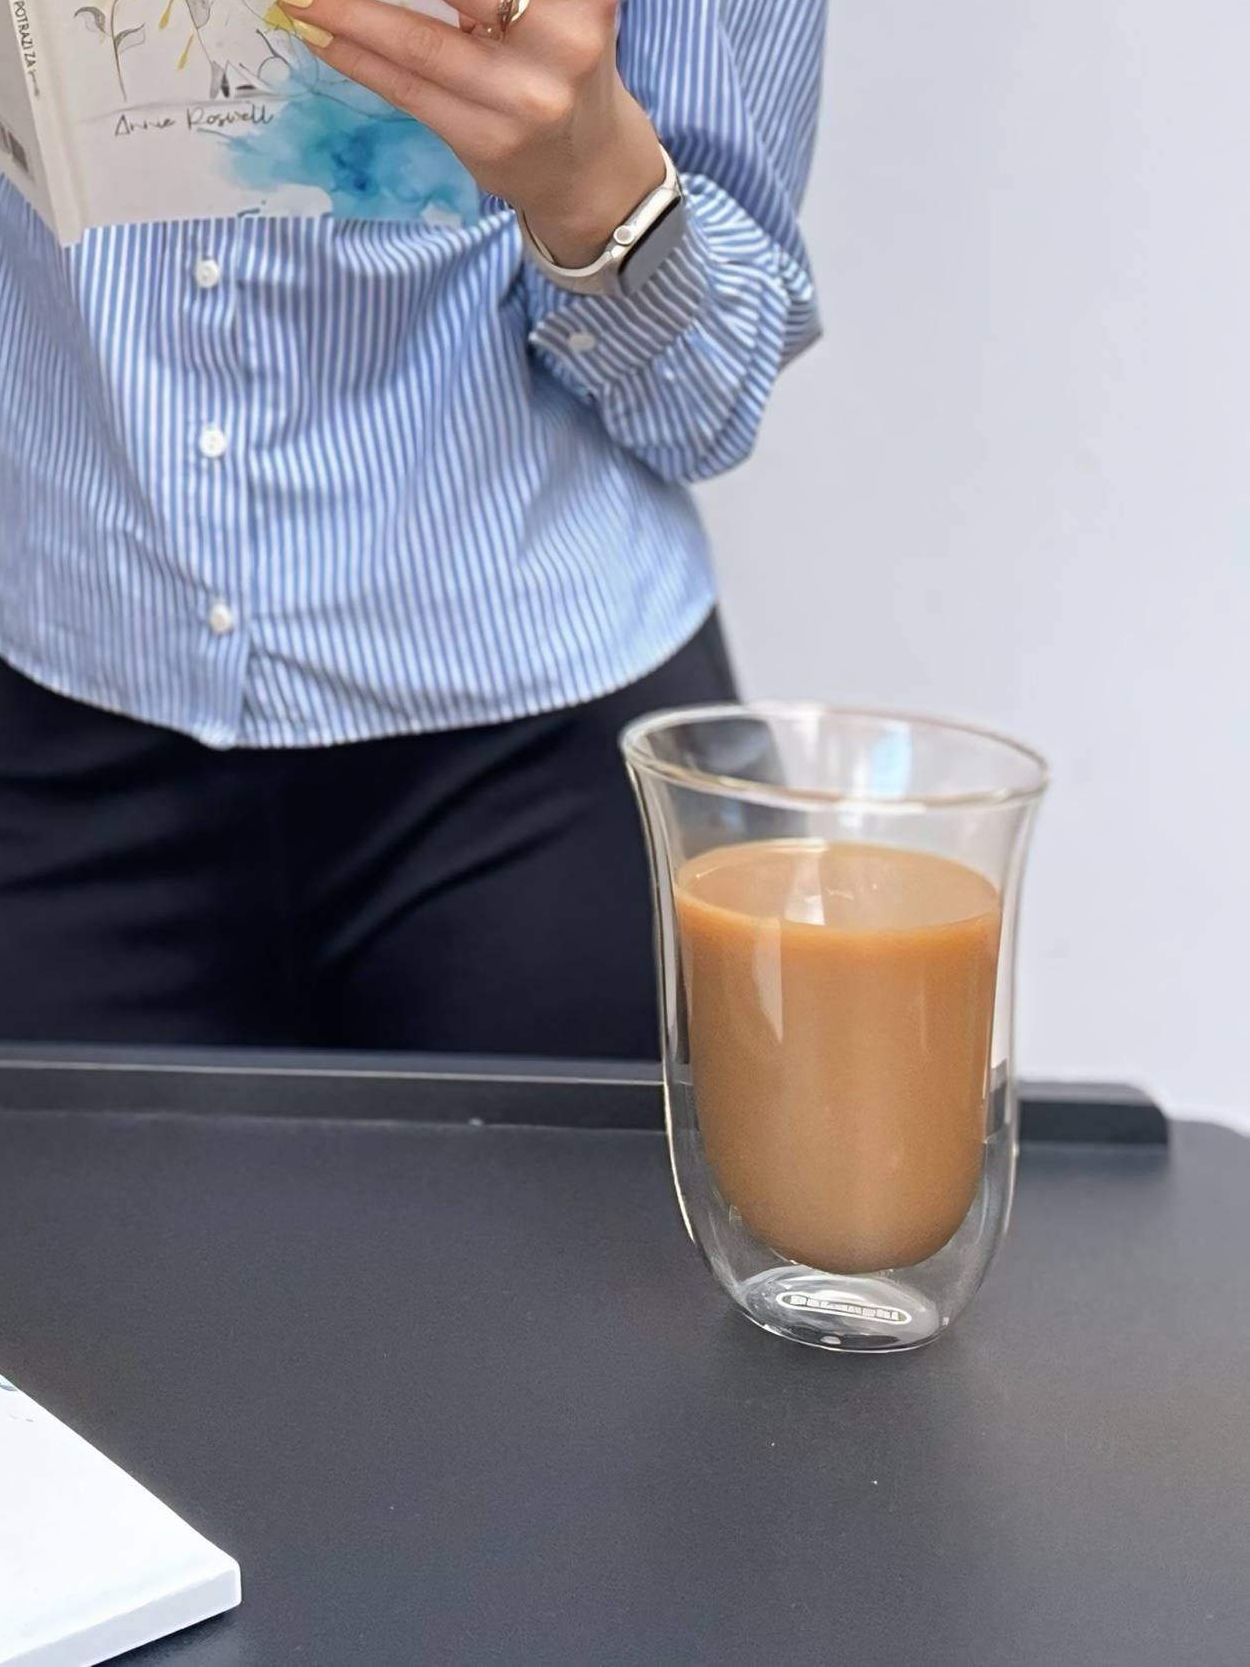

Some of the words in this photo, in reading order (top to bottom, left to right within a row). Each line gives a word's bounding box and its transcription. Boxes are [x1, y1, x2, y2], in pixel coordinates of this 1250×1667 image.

[13, 0, 35, 50] POTRAZI
[24, 50, 37, 69] ZA
[115, 114, 176, 137] Annie
[186, 104, 274, 130] Roswell
